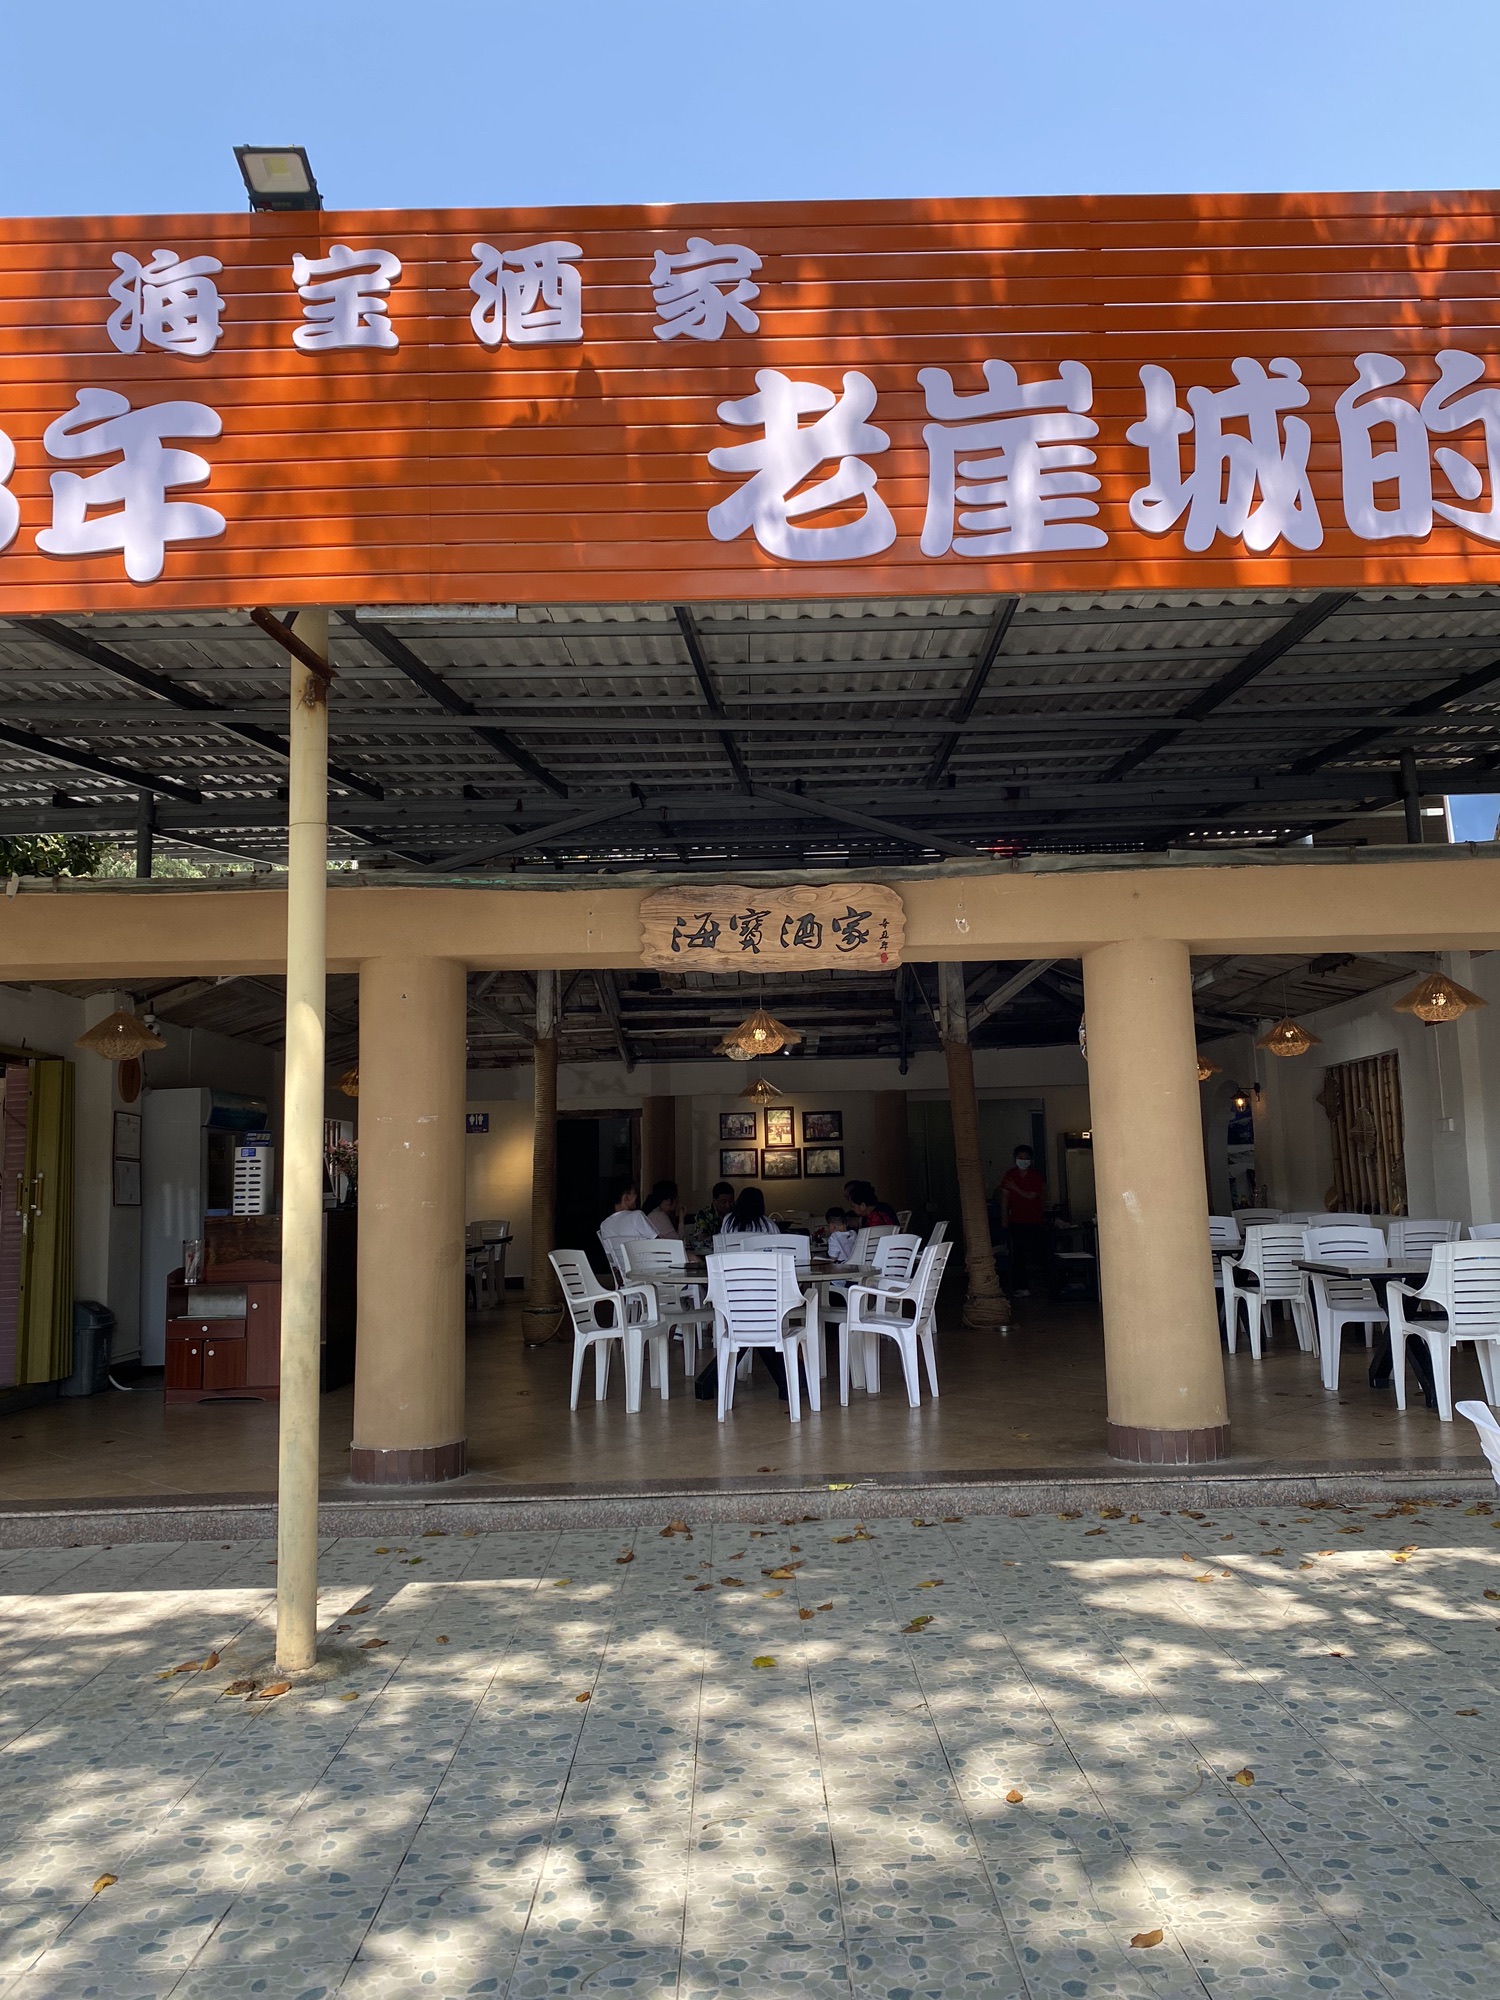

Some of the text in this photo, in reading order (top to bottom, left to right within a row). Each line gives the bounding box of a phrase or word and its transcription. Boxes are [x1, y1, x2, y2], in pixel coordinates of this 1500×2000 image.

[107, 237, 763, 356] 海宝酒家
[0, 349, 1500, 583] 年 老崖城的
